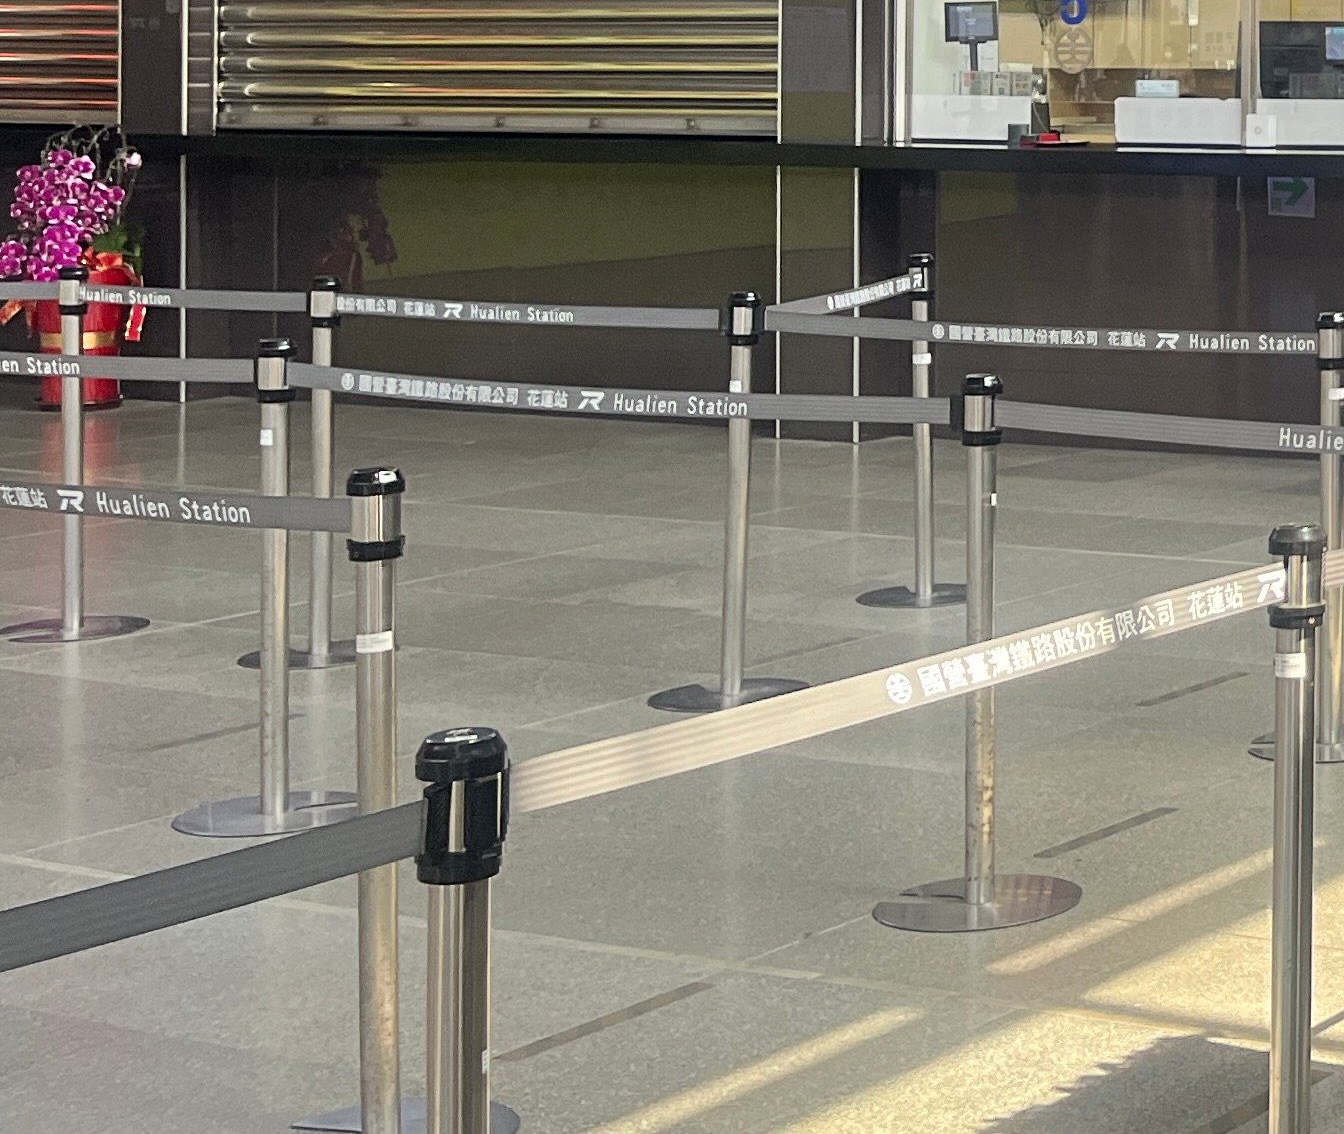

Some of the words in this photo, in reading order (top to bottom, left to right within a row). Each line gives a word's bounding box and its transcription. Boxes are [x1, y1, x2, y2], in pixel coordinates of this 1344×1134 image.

[128, 289, 171, 305] Station
[470, 306, 520, 321] Hualien
[527, 307, 574, 323] Station
[1188, 333, 1250, 351] Hualien
[1258, 334, 1315, 352] Station
[27, 356, 80, 375] Station
[527, 388, 569, 408] 花蓮站
[613, 393, 677, 415] Hualien
[687, 396, 748, 417] Station
[96, 491, 171, 520] Hualien
[180, 498, 251, 526] Station
[1188, 580, 1244, 621] 花蓮站
